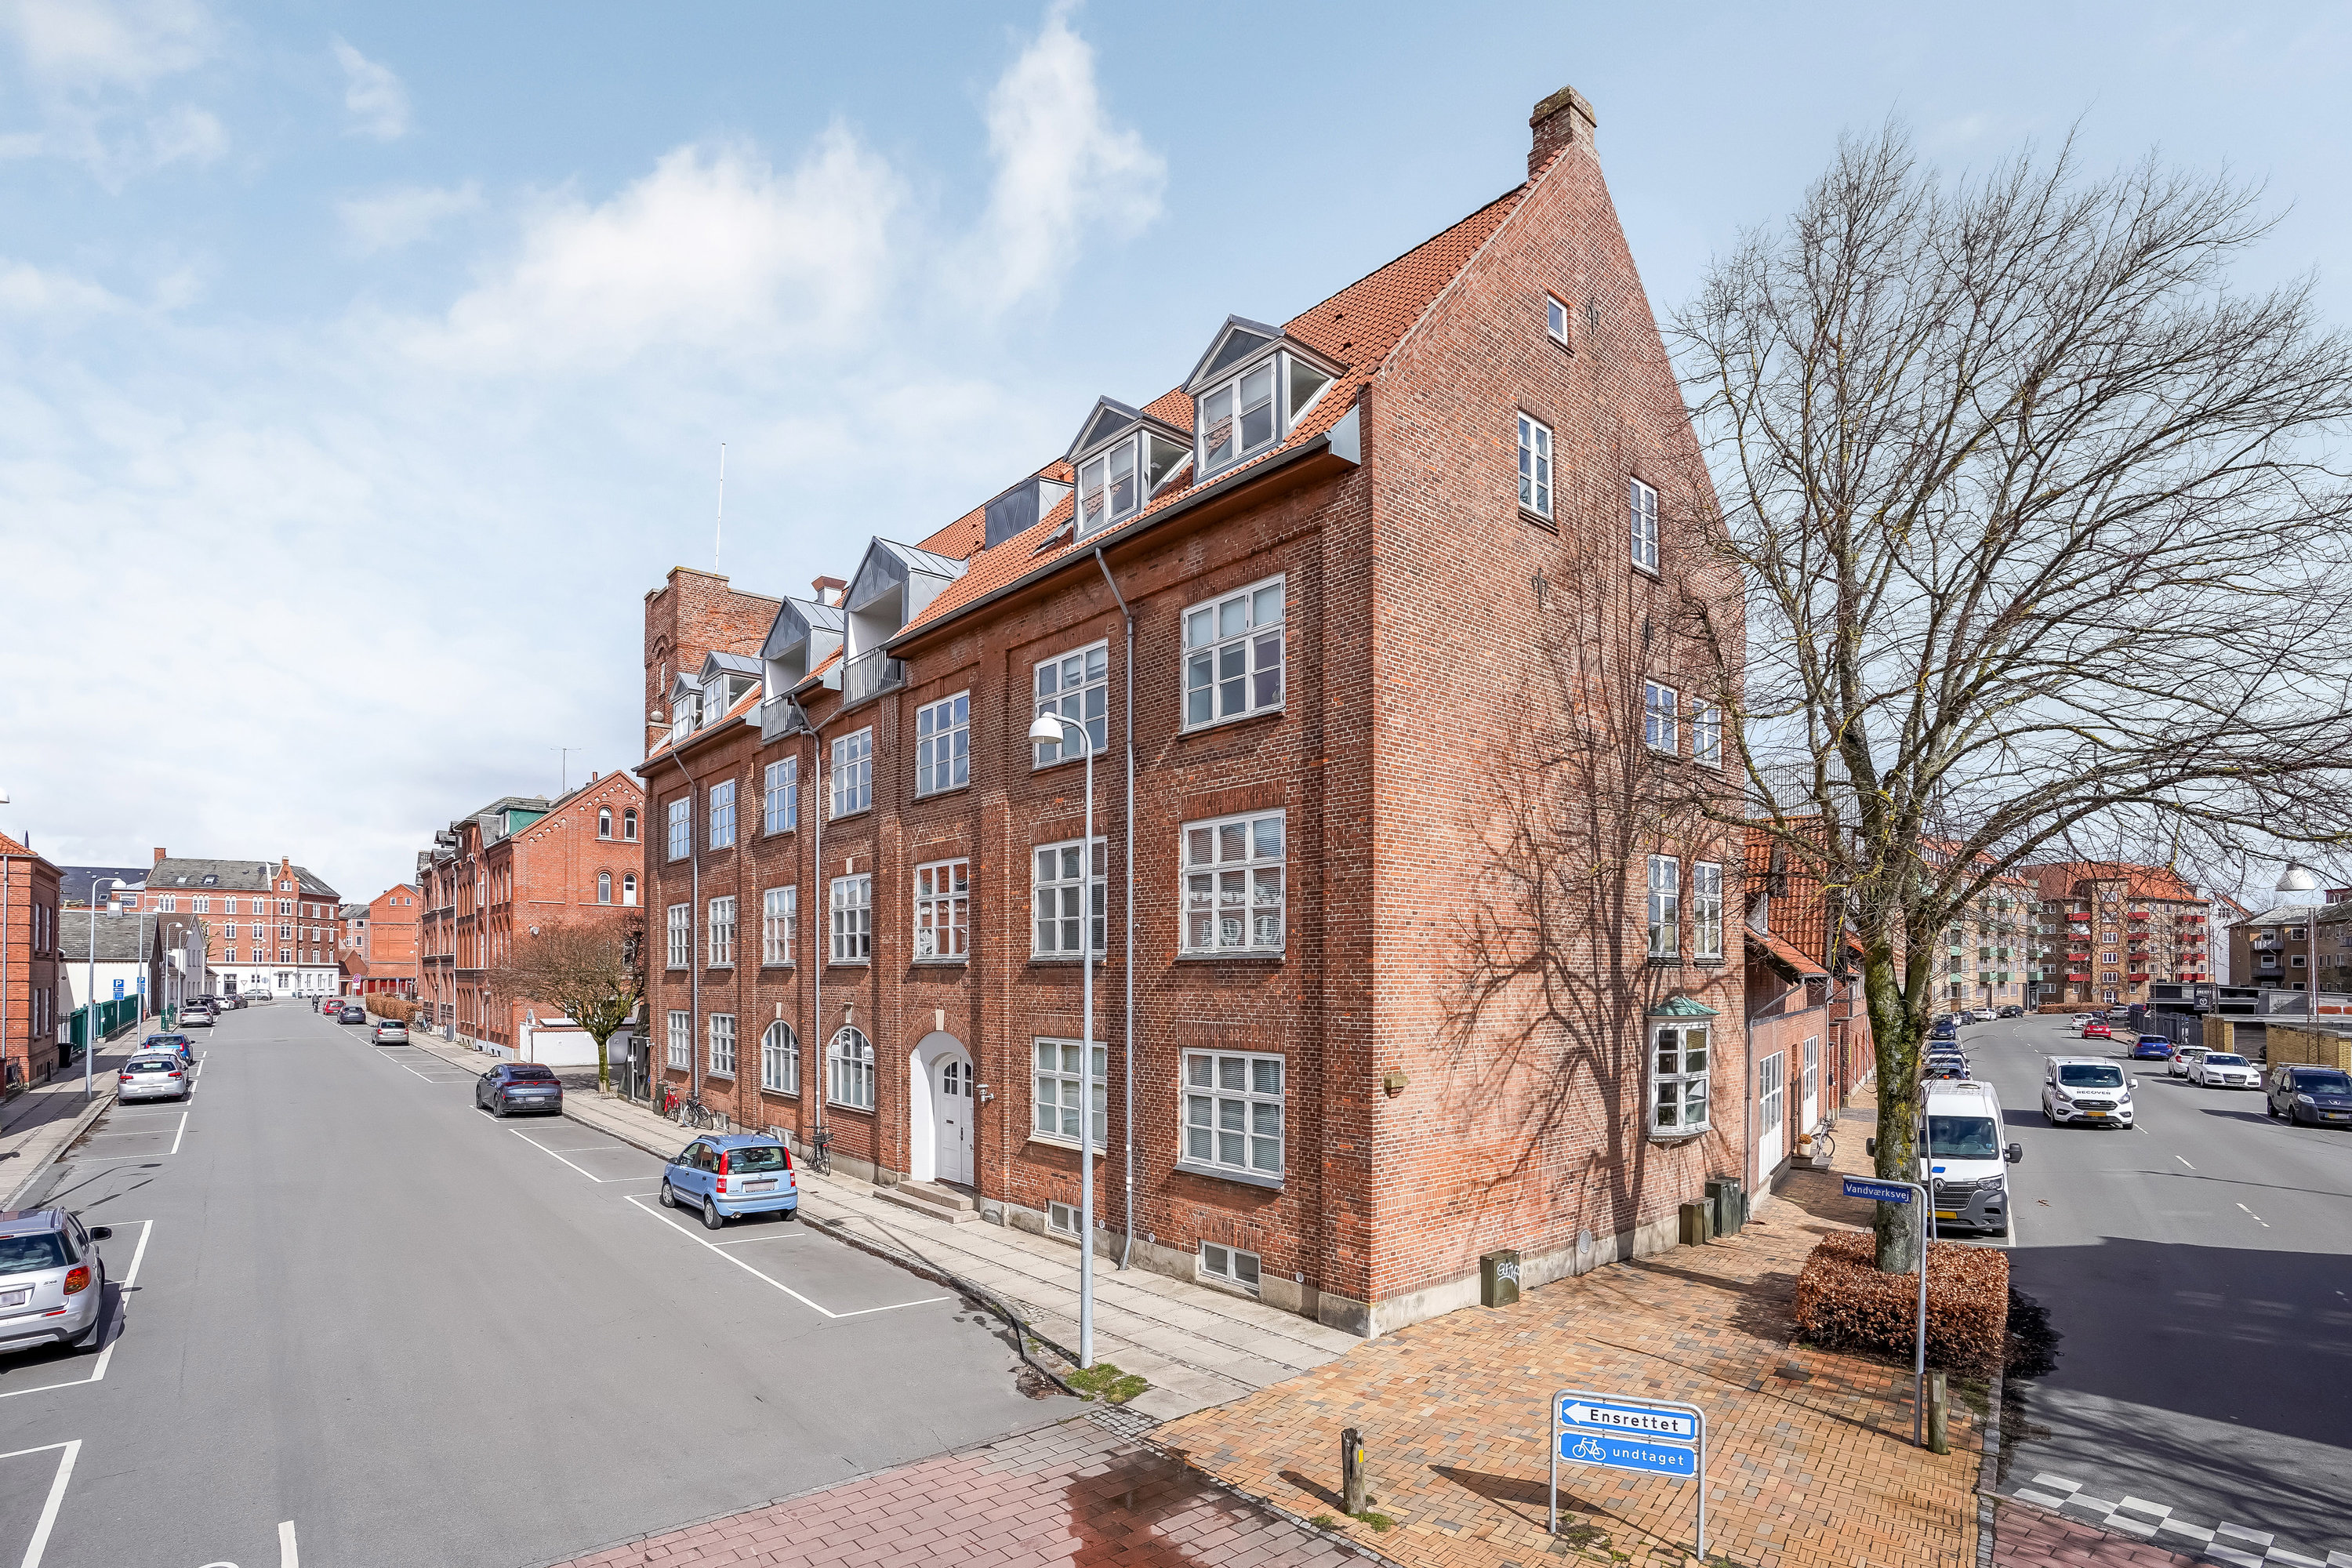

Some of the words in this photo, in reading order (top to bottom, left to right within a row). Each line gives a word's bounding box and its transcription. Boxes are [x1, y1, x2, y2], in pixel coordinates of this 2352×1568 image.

[1846, 1183, 1910, 1202] Vandværksvej
[1590, 1409, 1679, 1432] Ensrettet
[1613, 1448, 1684, 1466] undtaget
